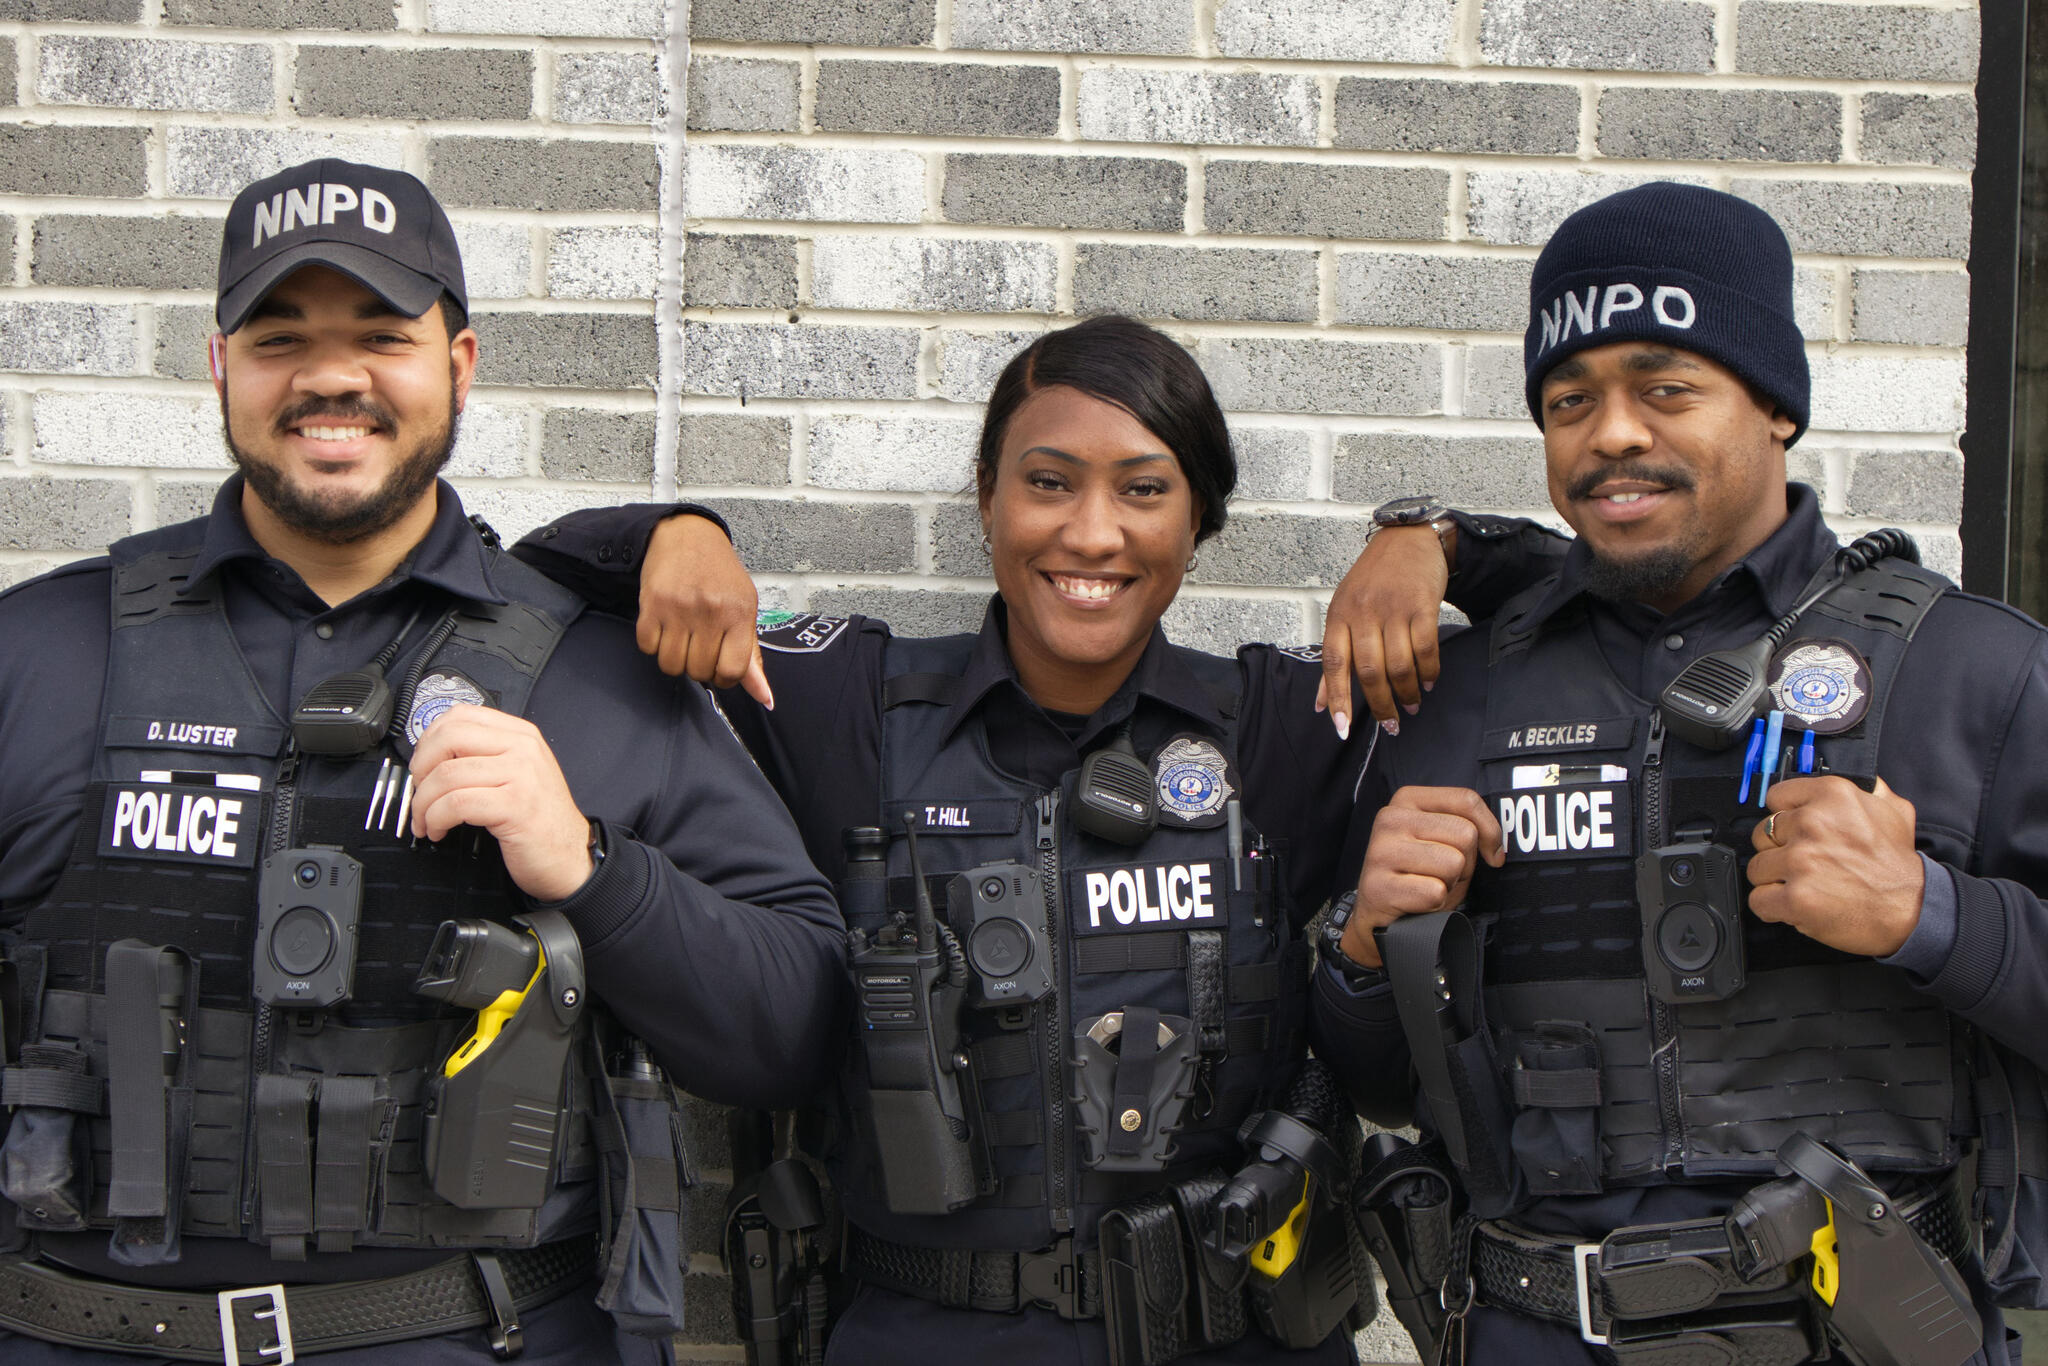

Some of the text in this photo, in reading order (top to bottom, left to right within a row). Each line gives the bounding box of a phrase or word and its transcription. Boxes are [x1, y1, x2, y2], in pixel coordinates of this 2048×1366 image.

[253, 183, 396, 249] NNPD
[1537, 283, 1696, 358] NNPD
[1794, 704, 1829, 714] POLICE
[147, 721, 238, 748] D. LUSTER
[1508, 724, 1597, 748] N. BECKLES
[1163, 764, 1219, 786] NEWPORT NEWS
[925, 806, 970, 827] T. HILL
[1172, 801, 1205, 811] POLICE
[112, 791, 242, 857] POLICE
[1500, 791, 1615, 853] POLICE
[1086, 864, 1214, 927] POLICE
[286, 981, 310, 990] AXON
[994, 981, 1016, 990] AXON
[1681, 977, 1705, 987] AXON
